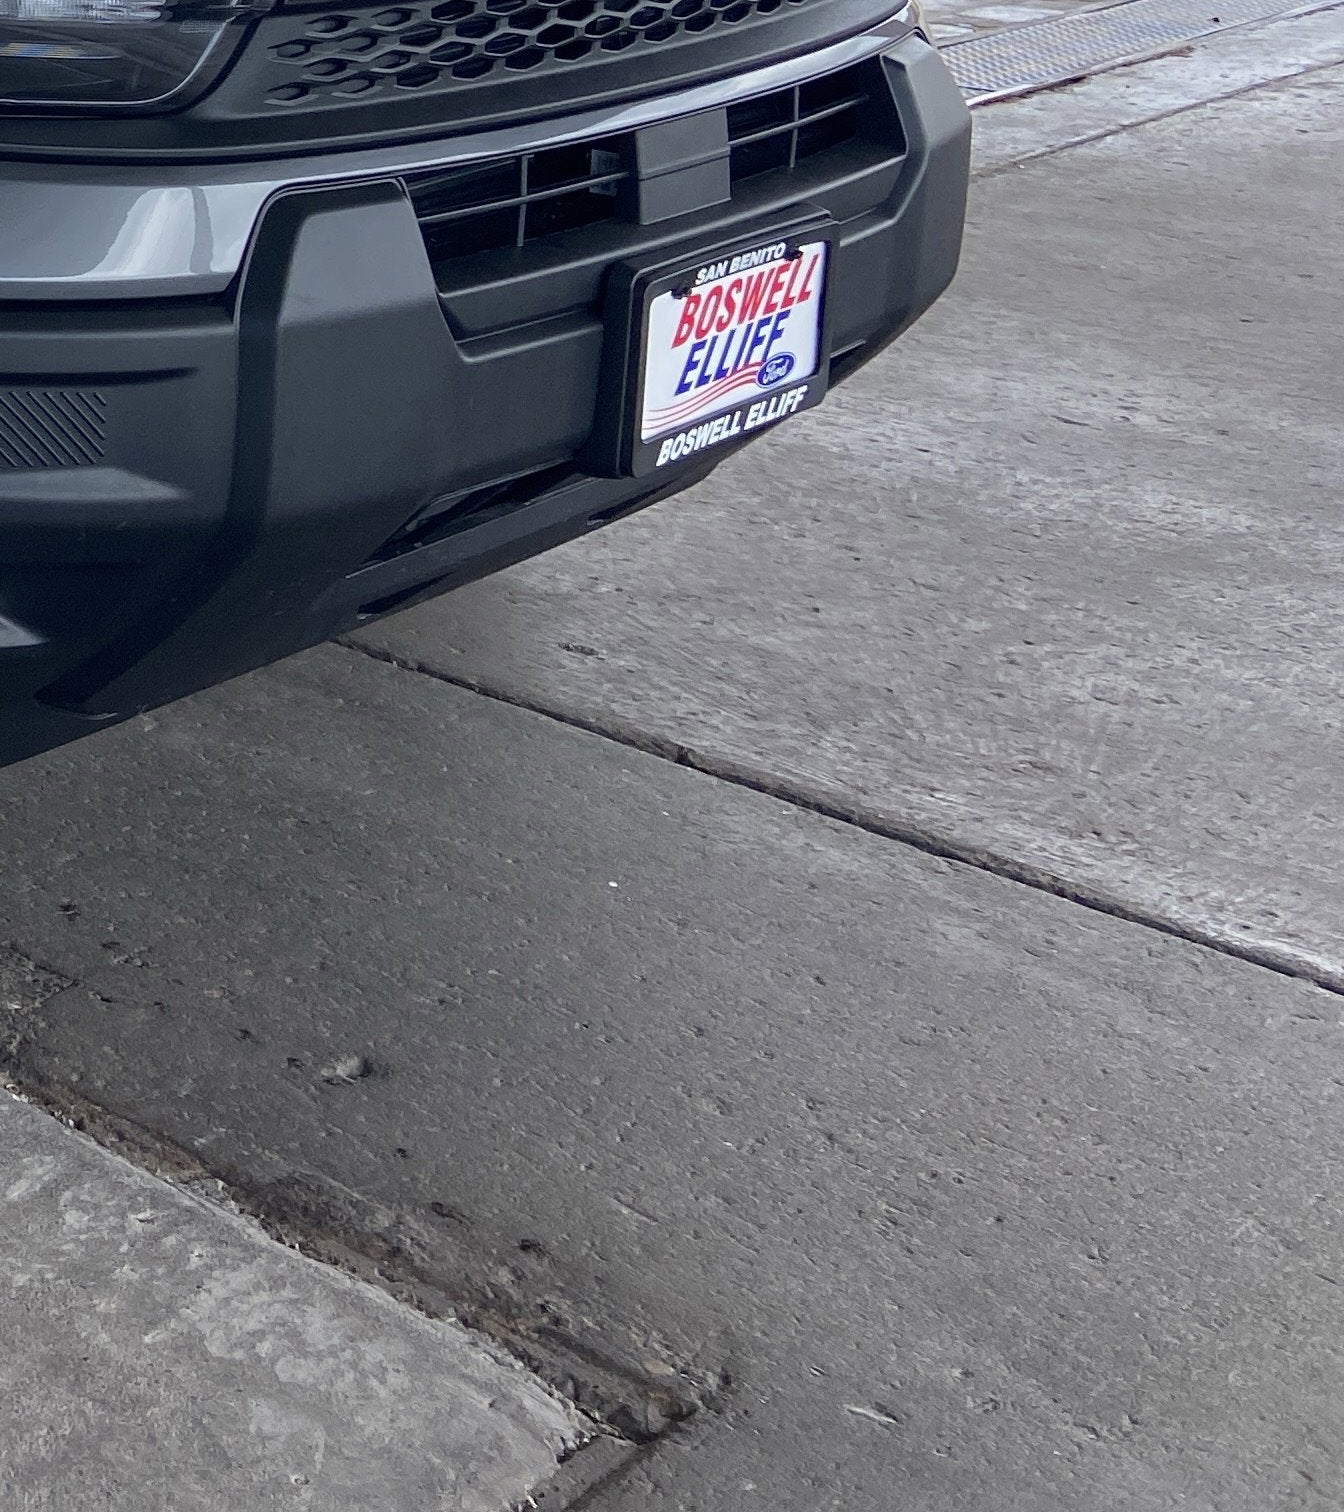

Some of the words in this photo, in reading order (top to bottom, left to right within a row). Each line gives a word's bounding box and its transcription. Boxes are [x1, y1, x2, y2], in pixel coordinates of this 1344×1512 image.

[671, 253, 820, 349] BOSWELL
[696, 260, 727, 285] SAN
[731, 242, 787, 273] BENITO
[674, 310, 791, 396] ELLIFF
[656, 410, 741, 467] BOSWELL
[744, 386, 808, 430] ELLIFF
